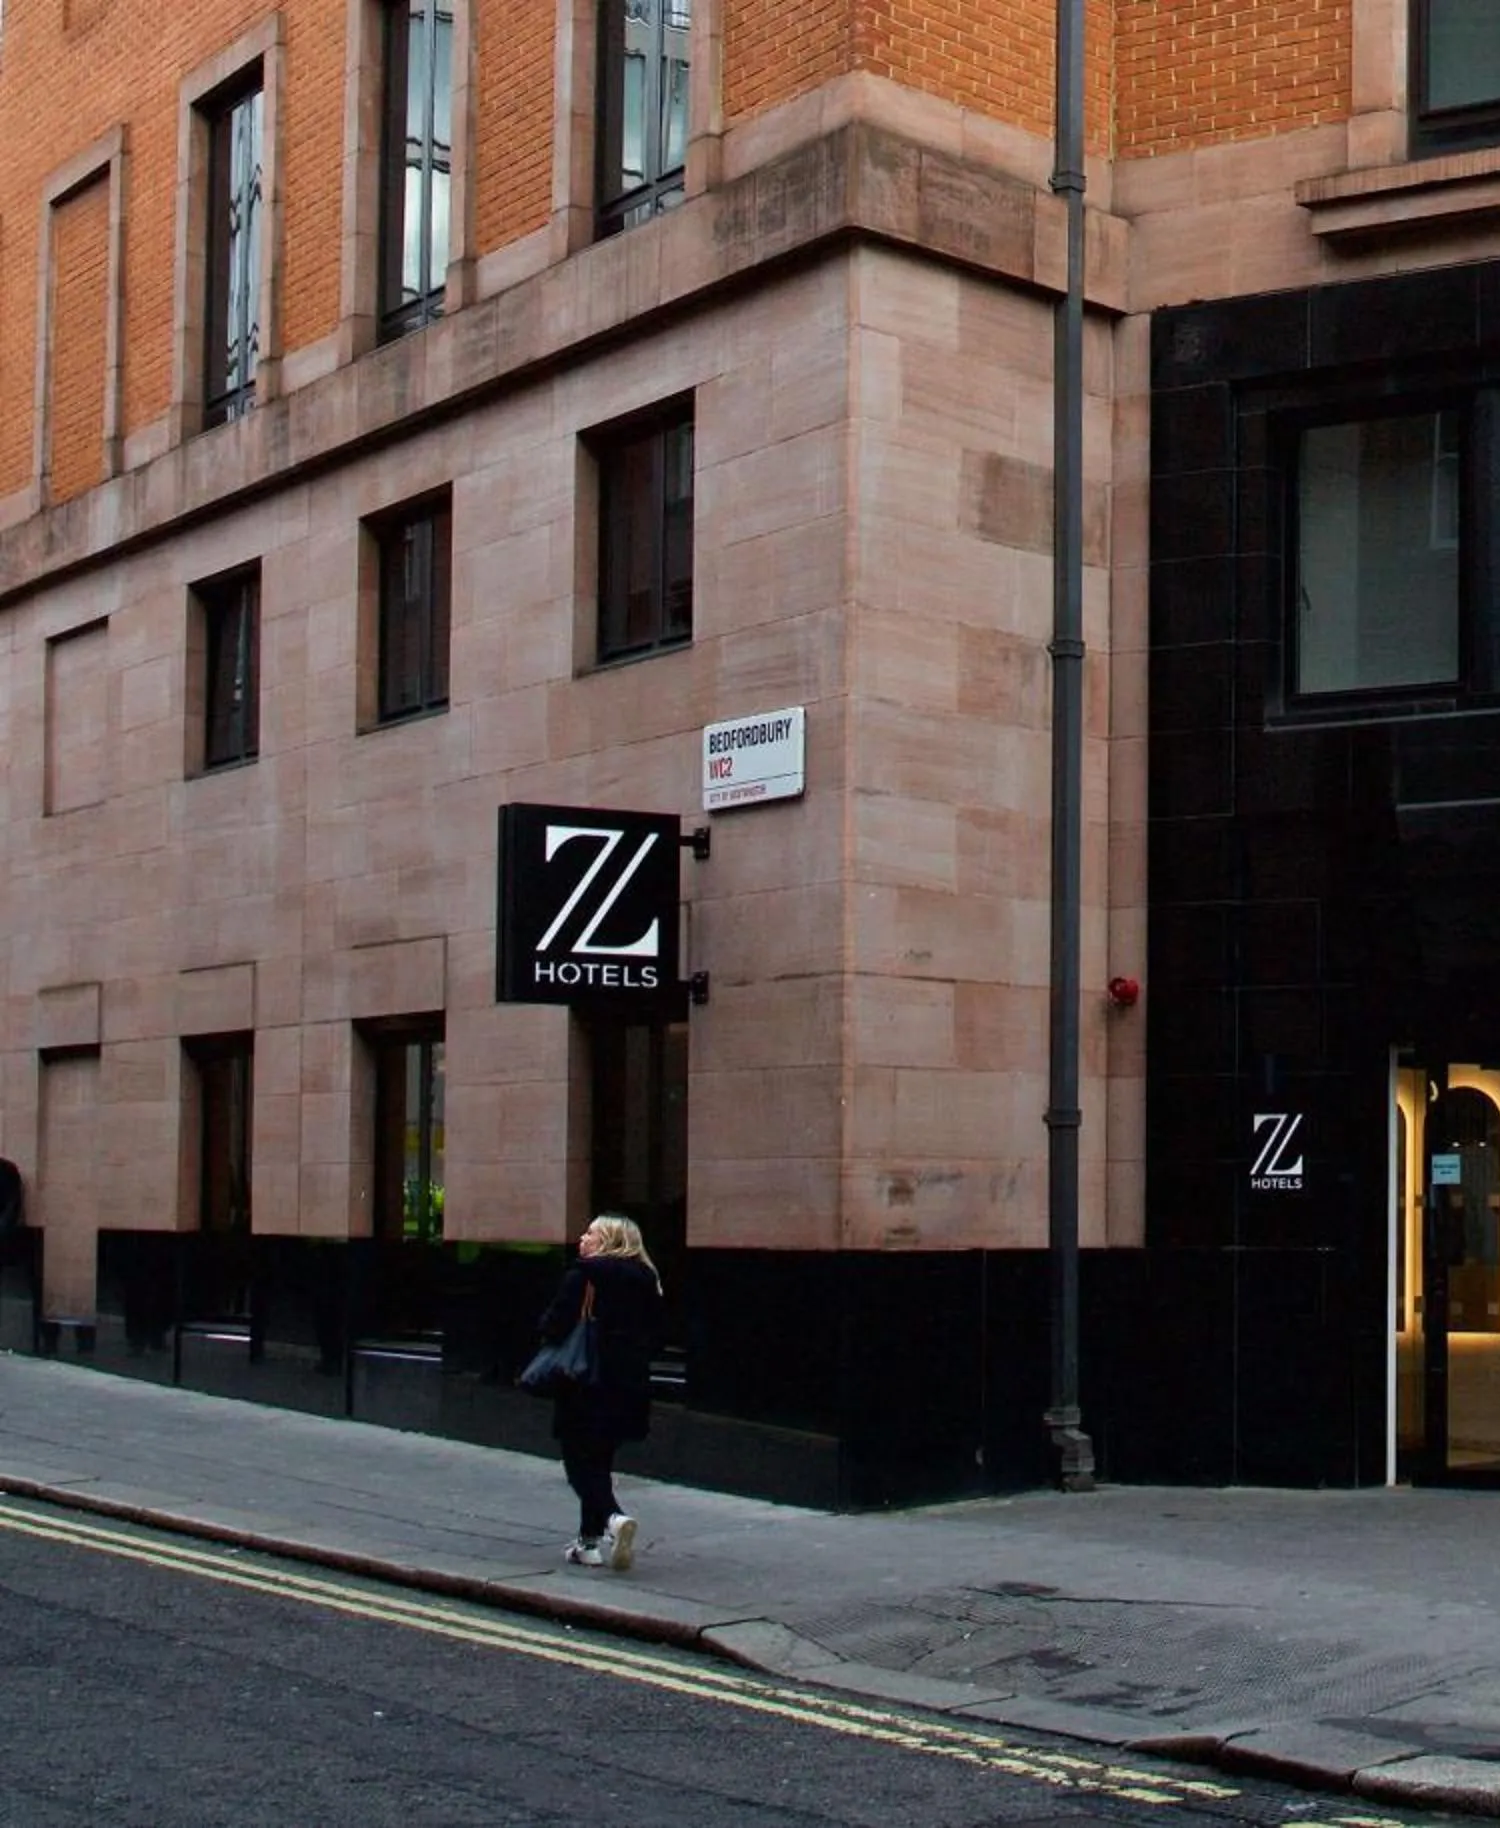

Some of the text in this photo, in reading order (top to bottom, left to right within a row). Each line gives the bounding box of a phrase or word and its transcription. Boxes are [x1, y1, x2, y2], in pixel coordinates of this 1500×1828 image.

[709, 718, 793, 755] BEDFORDBURY
[709, 757, 733, 780] WC2
[534, 961, 659, 989] HOTELS
[1251, 1177, 1303, 1190] HOTELS
